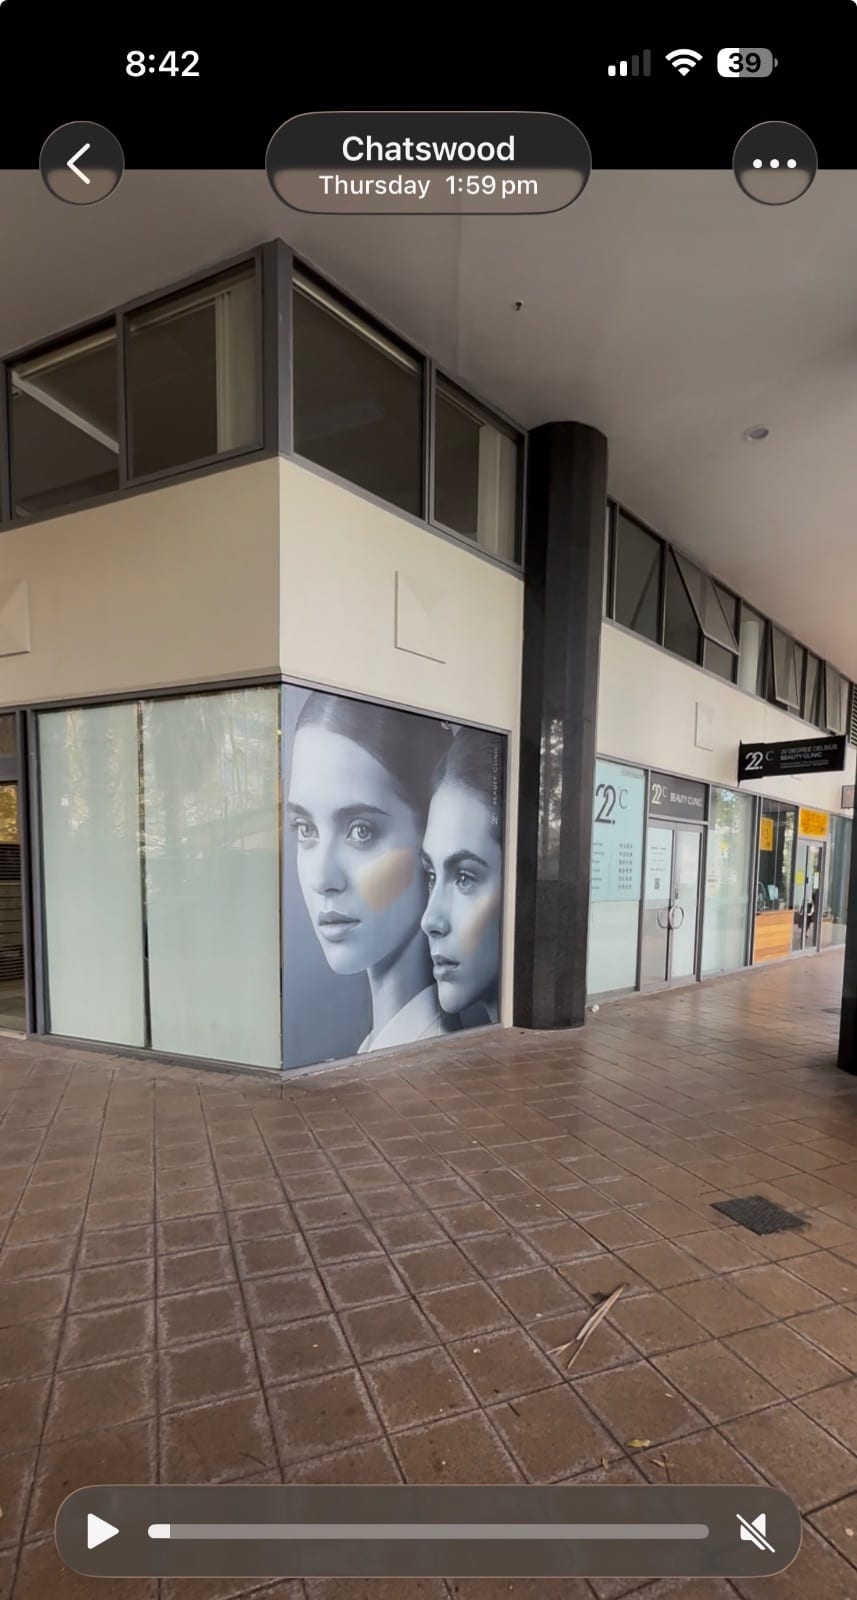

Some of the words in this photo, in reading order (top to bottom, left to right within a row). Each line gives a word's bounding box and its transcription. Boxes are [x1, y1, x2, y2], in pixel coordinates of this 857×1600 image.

[780, 753, 802, 761] BEAUTY
[803, 751, 822, 759] CLINIC
[670, 792, 687, 805] BEAUTY
[687, 796, 703, 808] CLINIC
